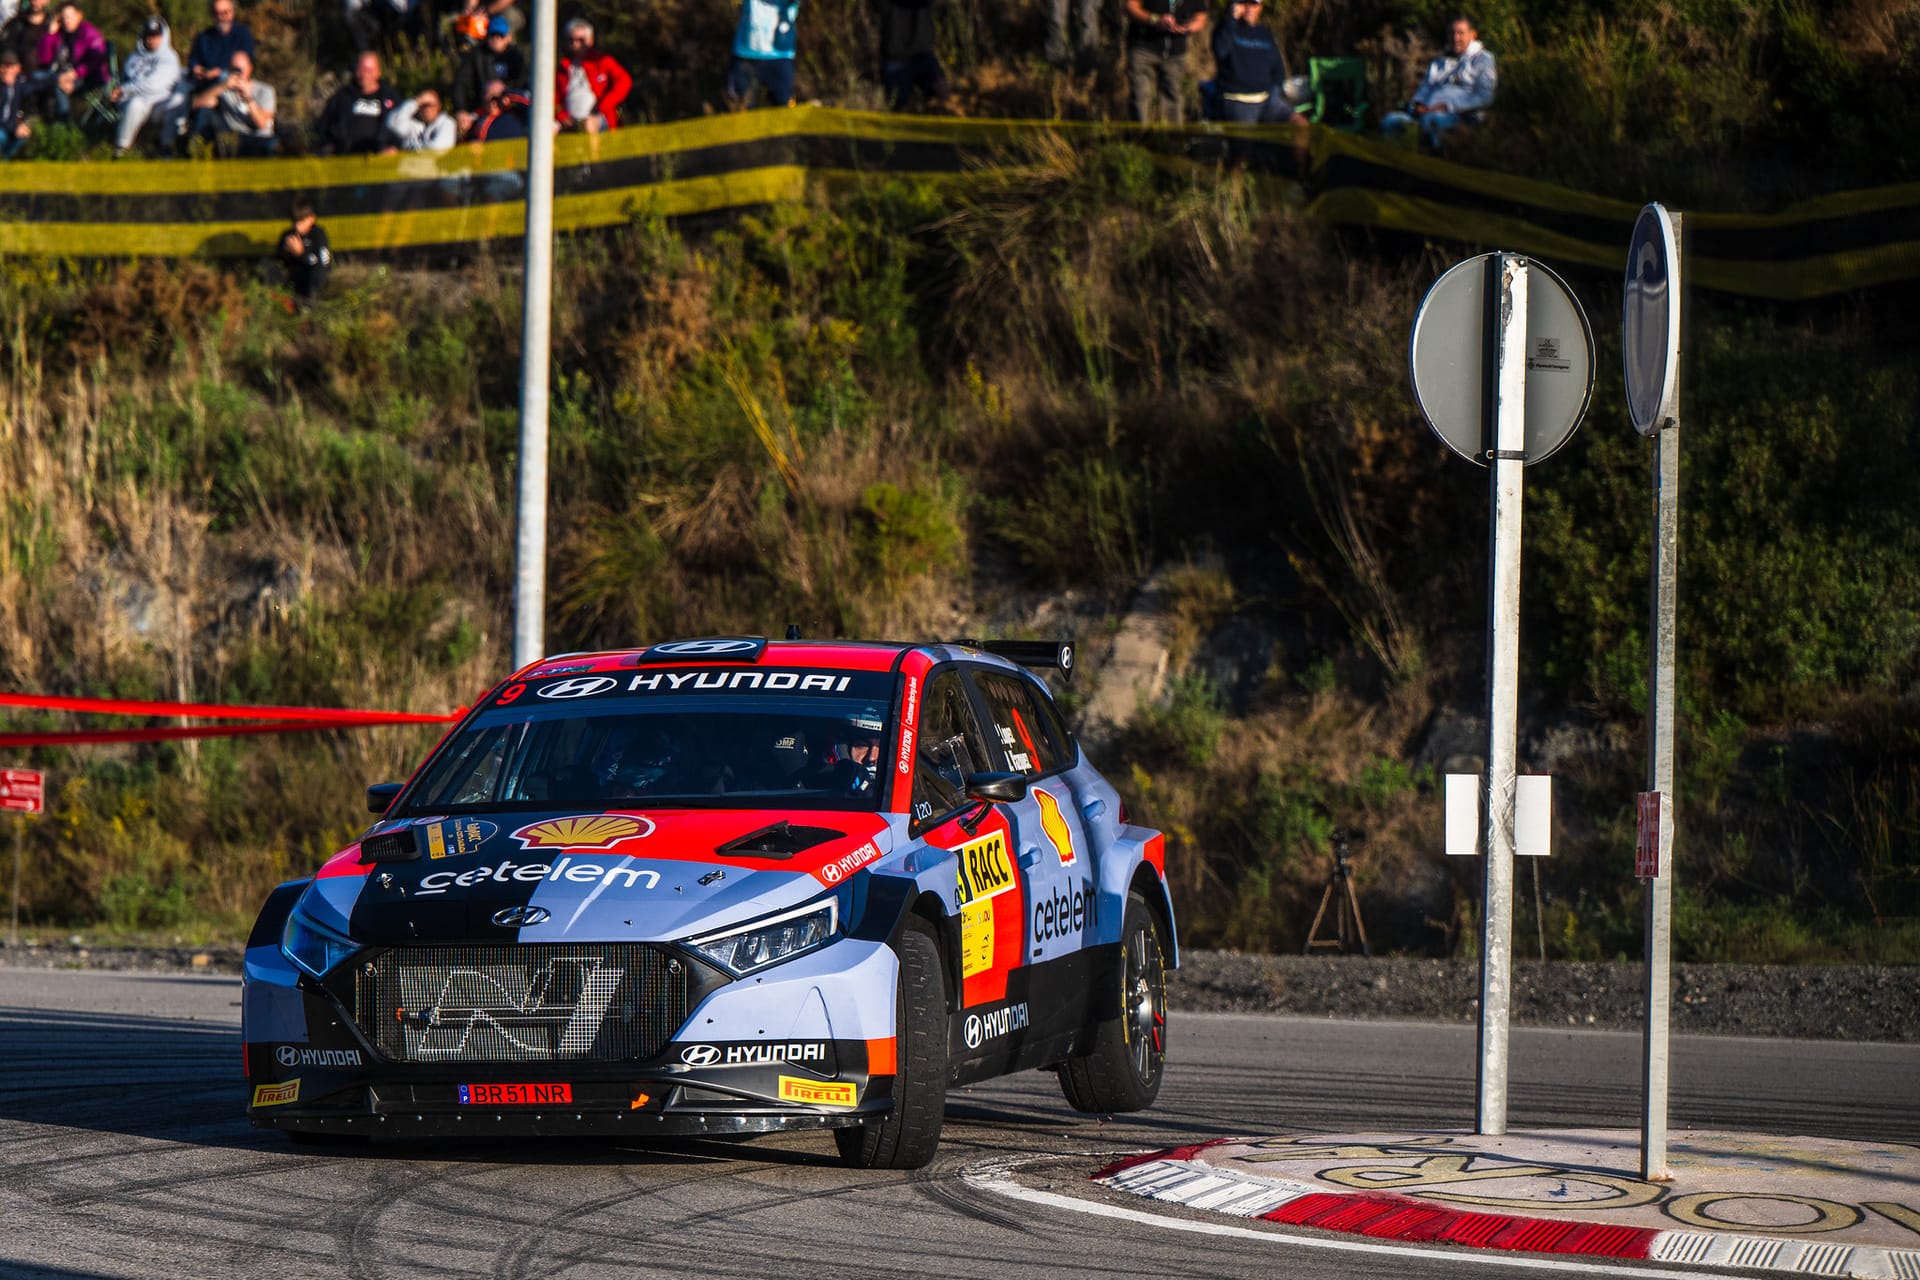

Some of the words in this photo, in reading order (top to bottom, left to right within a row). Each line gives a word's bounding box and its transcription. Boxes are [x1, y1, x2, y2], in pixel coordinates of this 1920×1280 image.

[627, 672, 851, 692] HYUNDAI
[496, 683, 527, 705] 9
[915, 801, 932, 821] i20
[838, 842, 877, 873] HYUNDAI
[969, 839, 1009, 893] RACC
[419, 858, 661, 889] cetelem
[1034, 876, 1098, 943] cetelem
[983, 1002, 1029, 1041] HYUNDAI
[299, 1050, 362, 1066] HYUNDAI
[726, 1043, 826, 1063] HYUNDAI
[256, 1083, 297, 1103] PIRELLI
[473, 1084, 502, 1102] BR
[506, 1084, 528, 1102] 51
[533, 1084, 565, 1102] NR
[784, 1080, 851, 1102] PIRELLI
